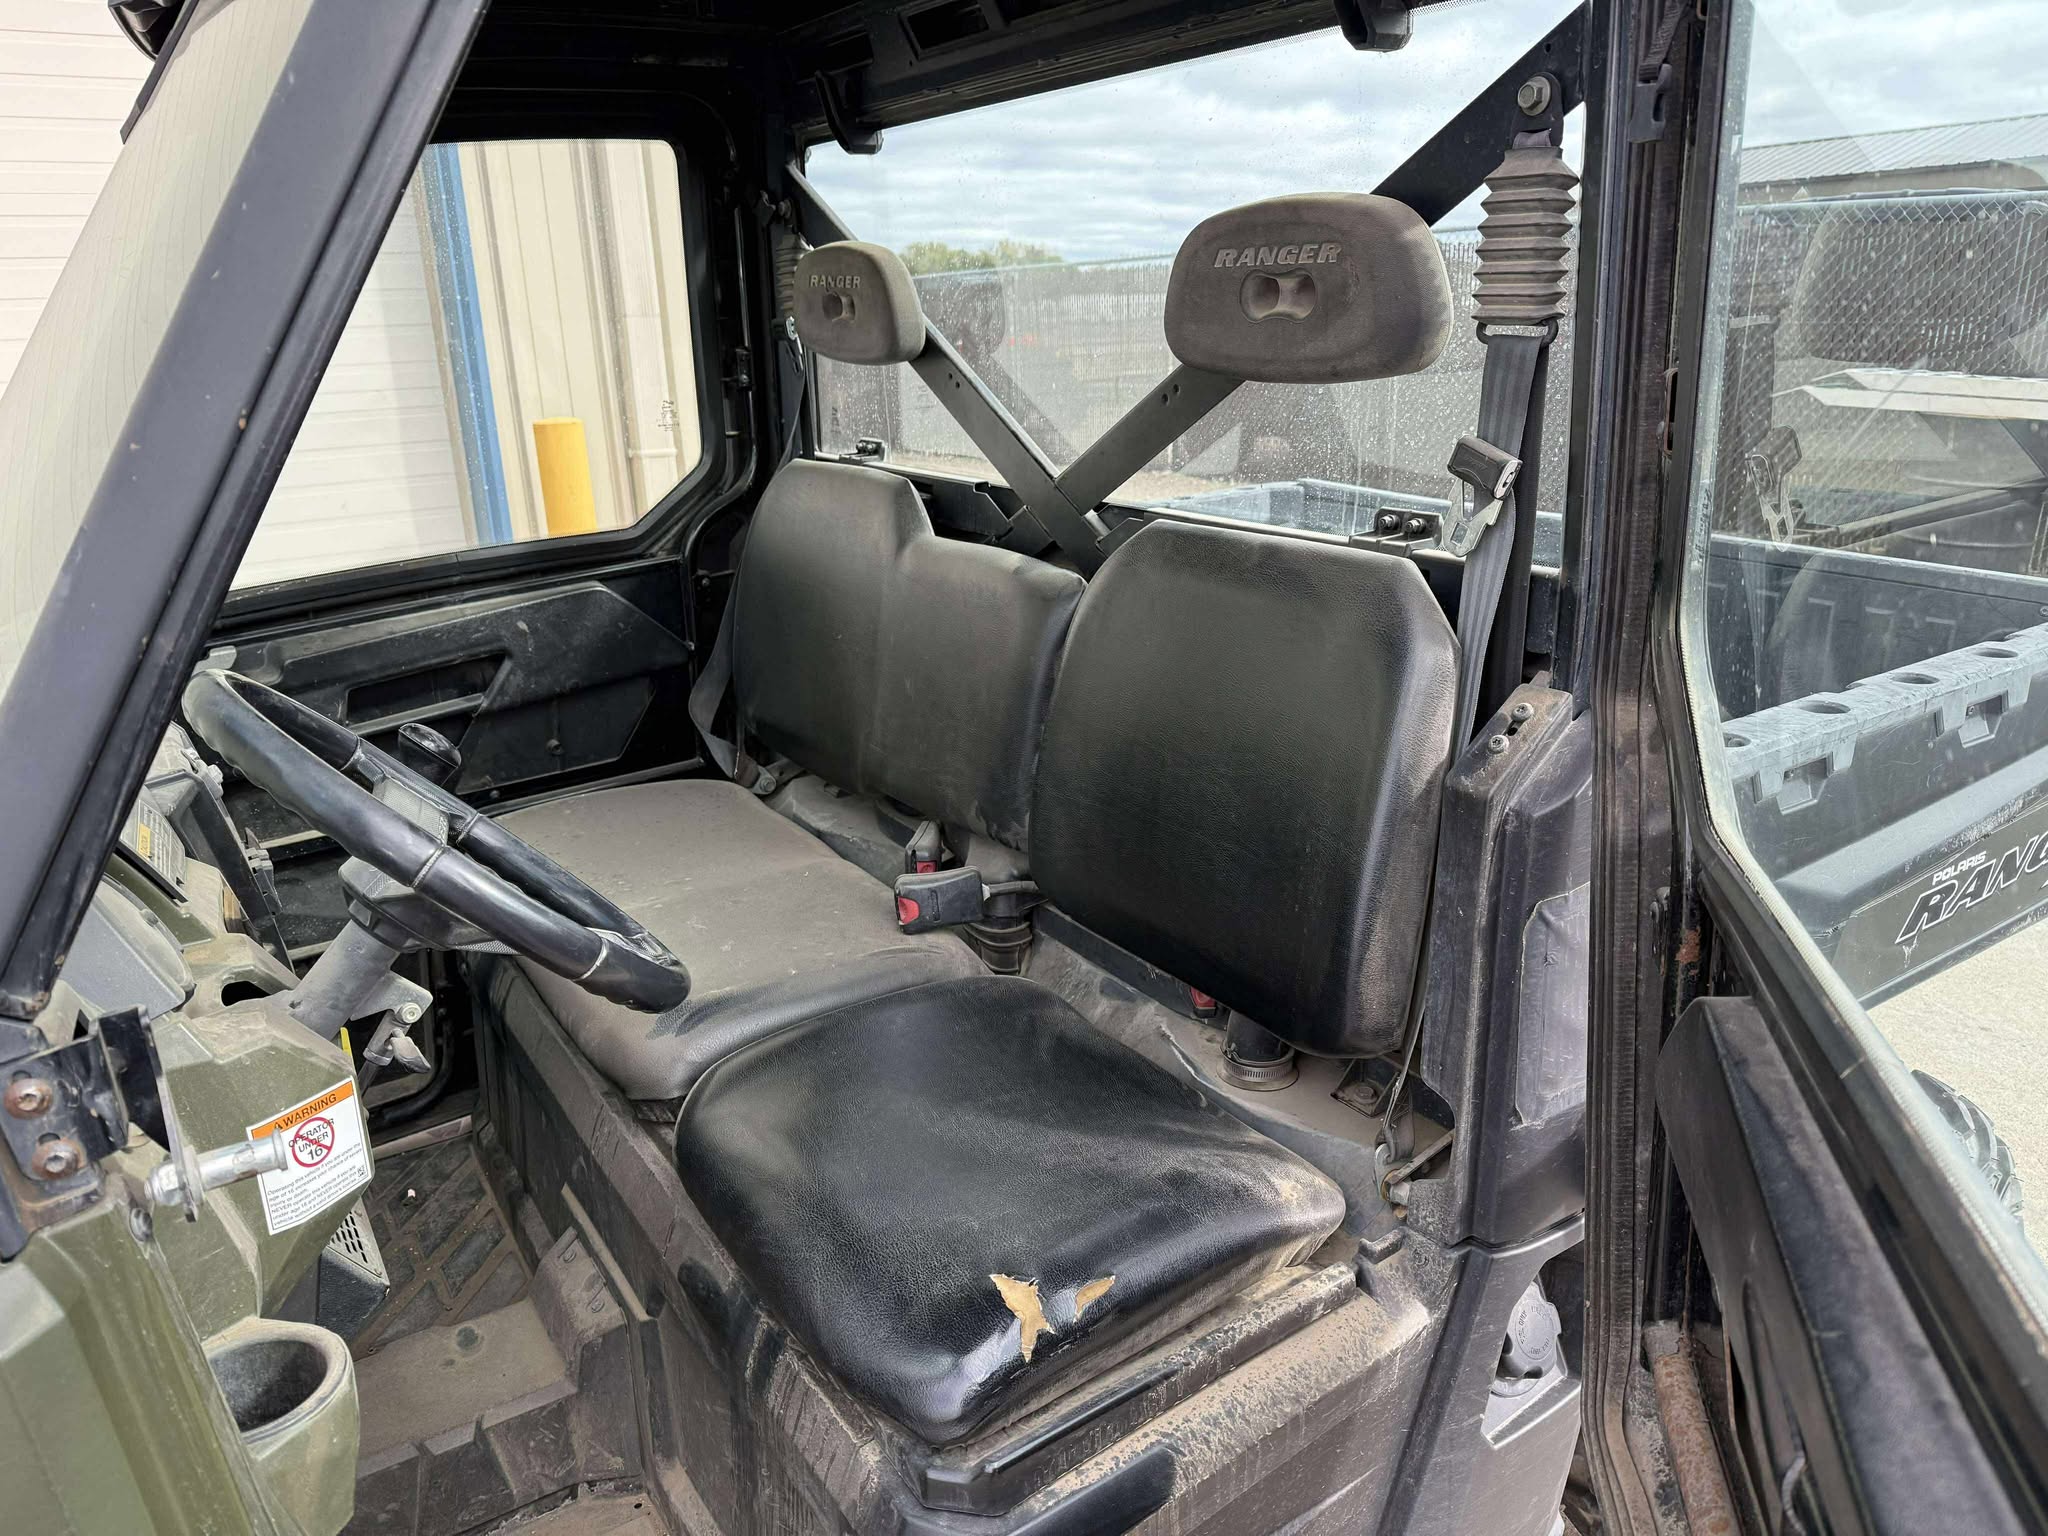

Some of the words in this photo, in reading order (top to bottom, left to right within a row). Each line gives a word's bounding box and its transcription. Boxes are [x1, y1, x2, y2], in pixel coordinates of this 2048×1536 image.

[1214, 243, 1341, 267] RANGER
[810, 275, 861, 289] RANGER
[1932, 851, 1987, 885] POLARIS
[283, 1094, 337, 1128] WARNING
[288, 1118, 335, 1148] OPERATOR
[298, 1131, 329, 1153] UNDER
[307, 1146, 323, 1161] 16
